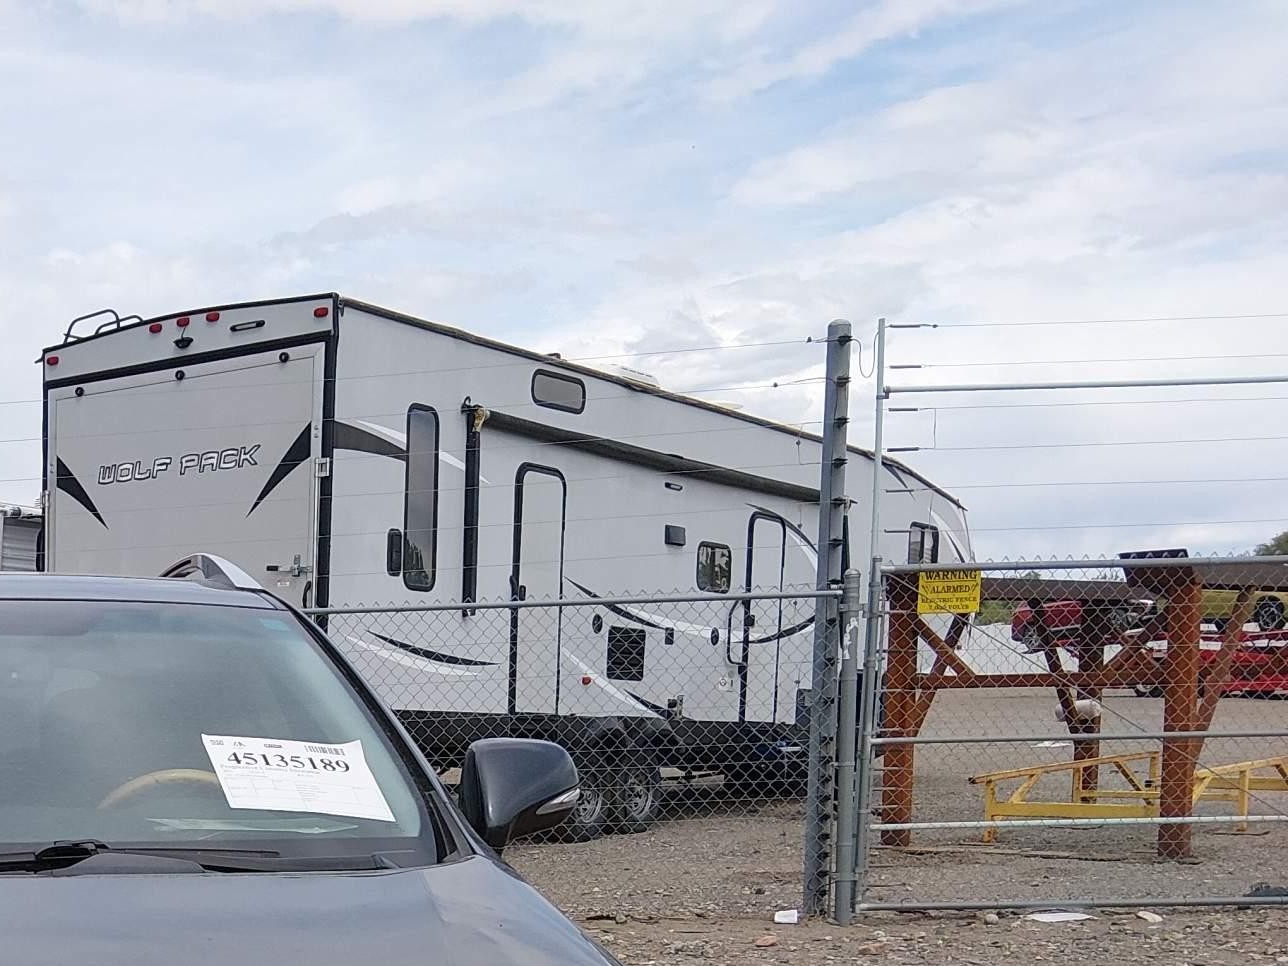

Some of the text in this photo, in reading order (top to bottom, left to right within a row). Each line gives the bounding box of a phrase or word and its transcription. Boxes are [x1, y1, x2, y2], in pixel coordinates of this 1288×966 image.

[98, 444, 261, 485] WOLF PACK
[925, 570, 977, 580] WARNING
[931, 585, 970, 594] ALARMED
[227, 752, 350, 773] 45135189
